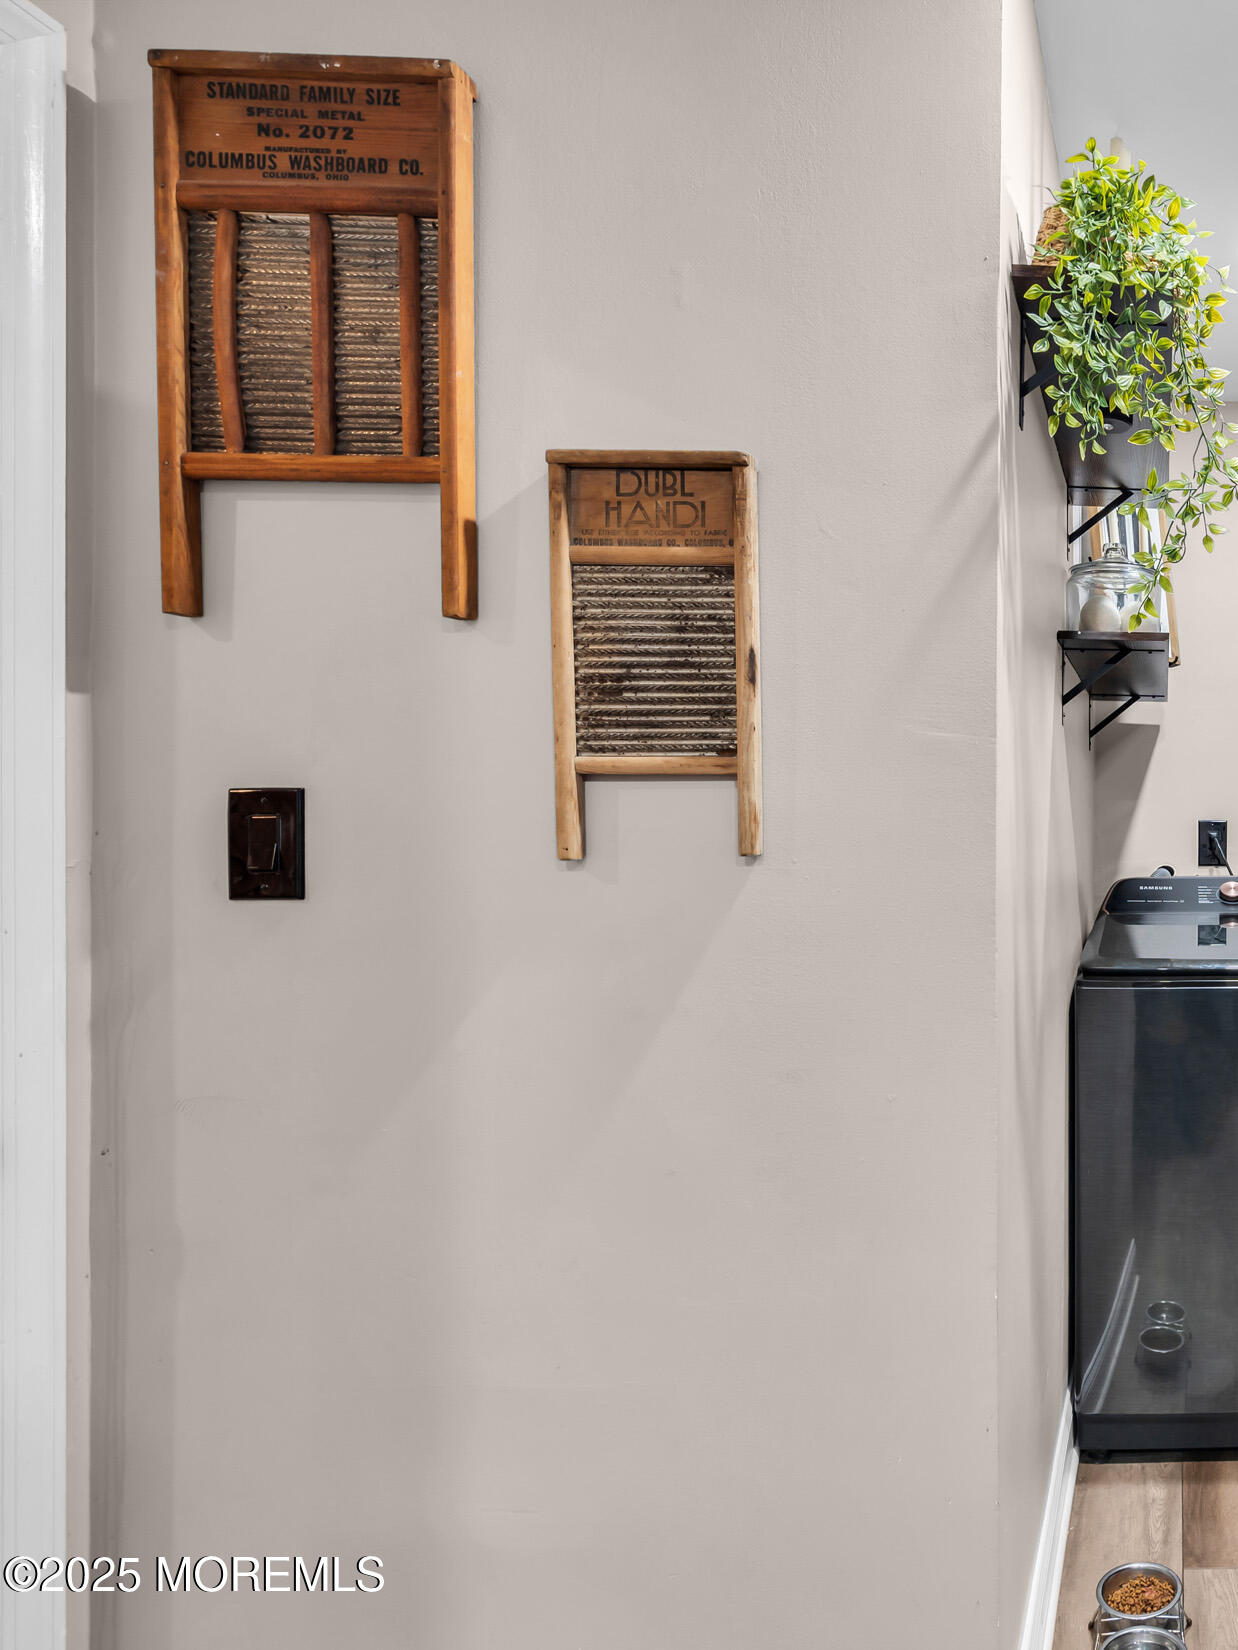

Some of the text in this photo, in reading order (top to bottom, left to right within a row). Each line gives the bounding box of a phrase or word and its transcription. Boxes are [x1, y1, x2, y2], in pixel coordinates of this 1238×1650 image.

[206, 81, 401, 107] STANDARD FAMILY SIZE
[246, 106, 366, 122] SPECIAL METAL
[256, 123, 355, 141] No. 2072
[264, 146, 331, 155] MANUFACTURED
[184, 150, 424, 177] COLUMBUS WASHBOARD CO.
[325, 173, 349, 182] OHIO
[615, 469, 695, 498] DUBL
[604, 500, 706, 529] HANDI
